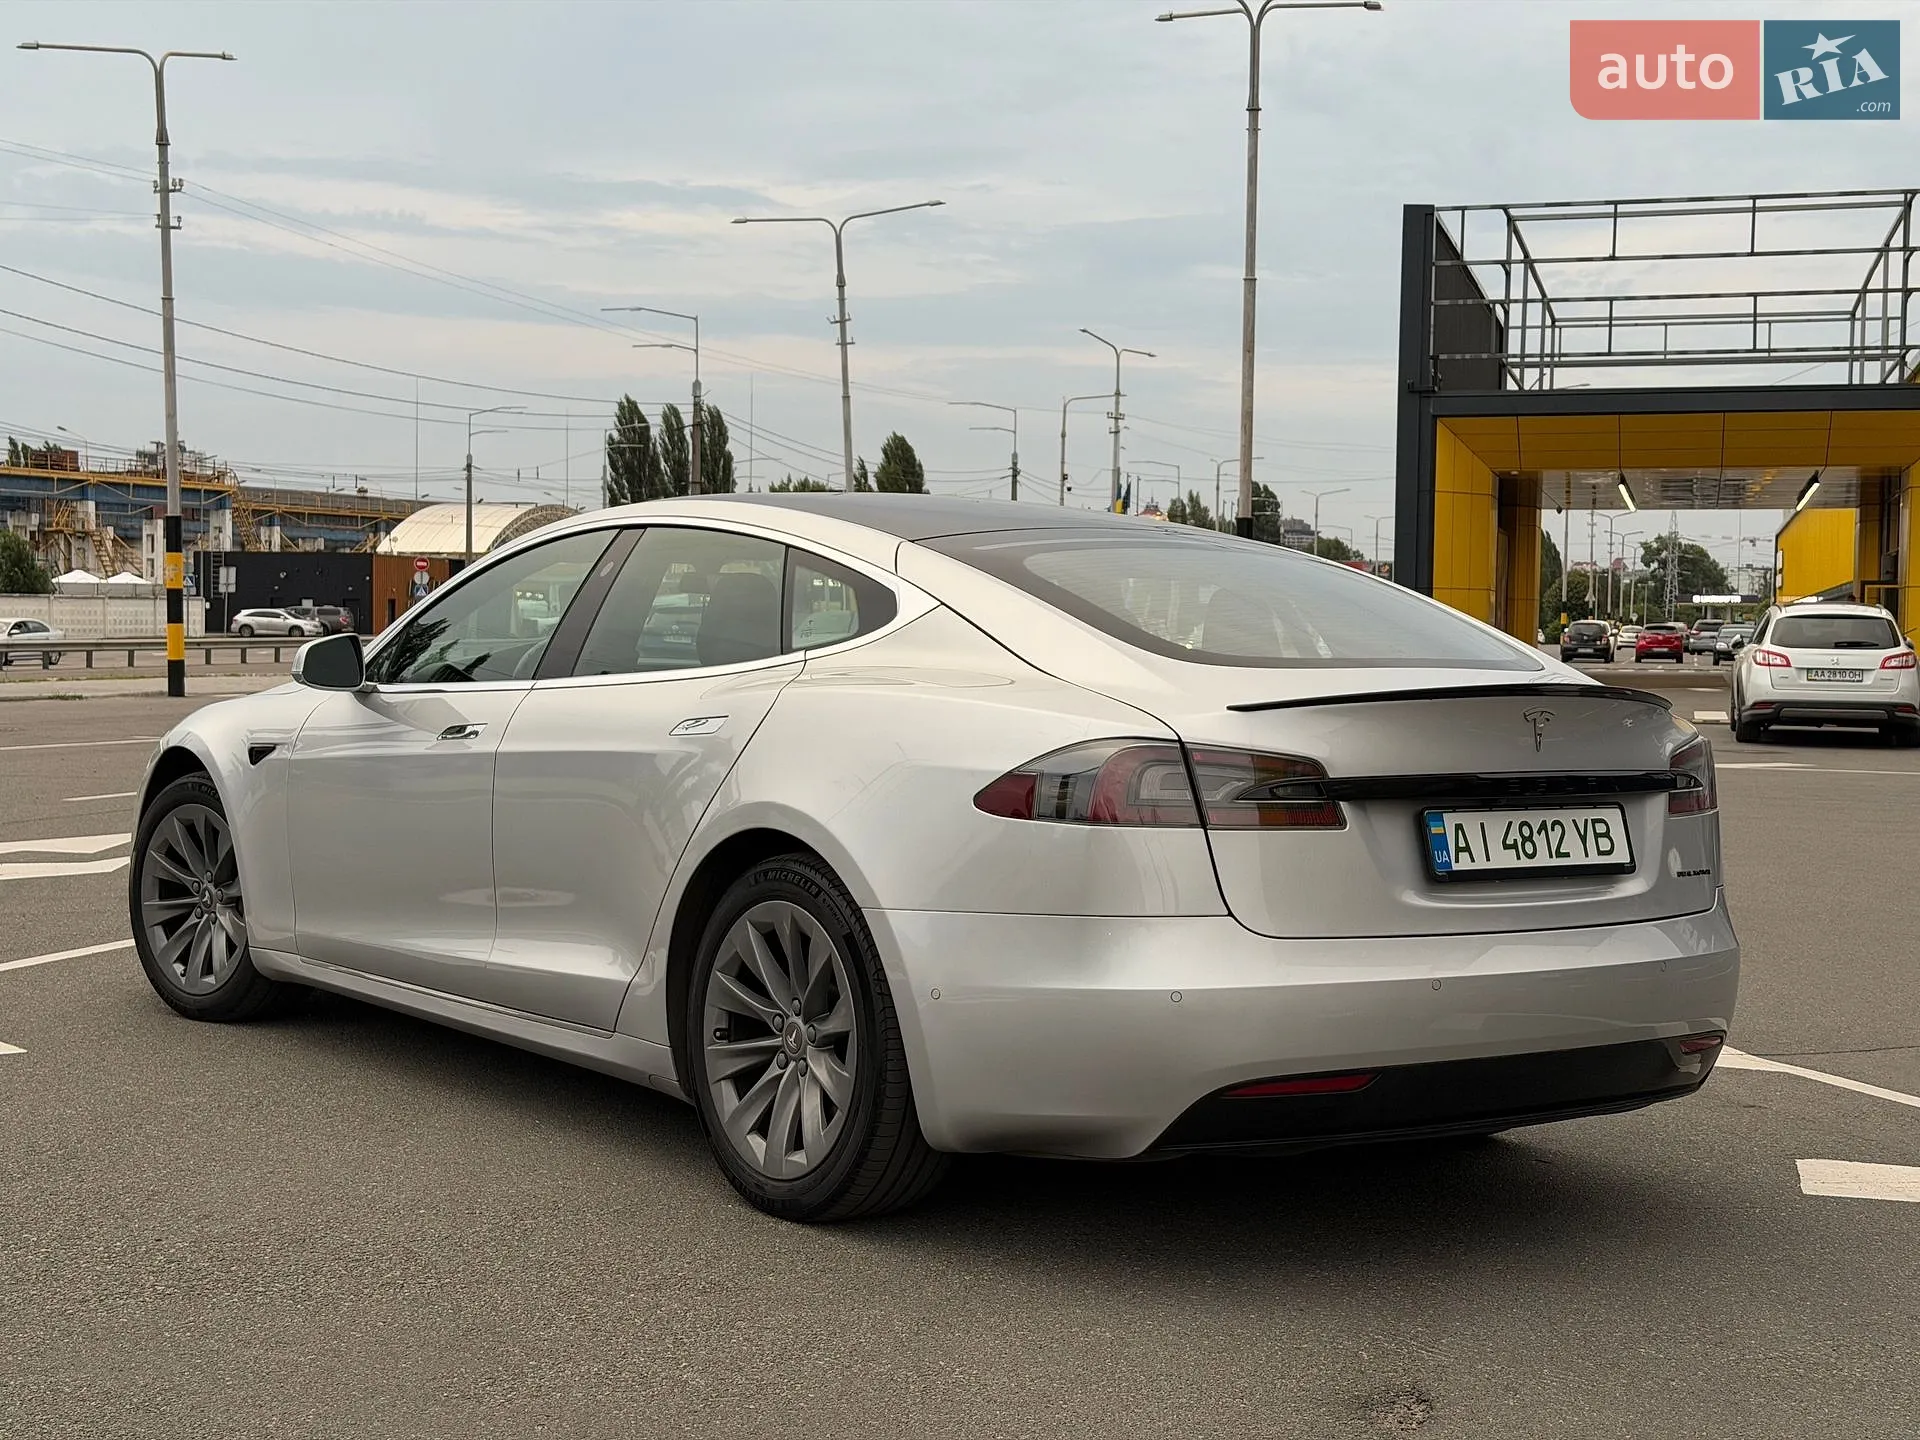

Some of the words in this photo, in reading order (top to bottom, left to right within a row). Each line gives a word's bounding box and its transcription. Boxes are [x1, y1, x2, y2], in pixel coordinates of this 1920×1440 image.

[1813, 670, 1826, 678] AA
[1827, 670, 1847, 679] 2810
[1454, 822, 1491, 864] AI
[1501, 819, 1571, 861] 4812
[1572, 817, 1616, 859] YB
[1434, 850, 1450, 863] UA
[767, 870, 819, 896] MICHELIN
